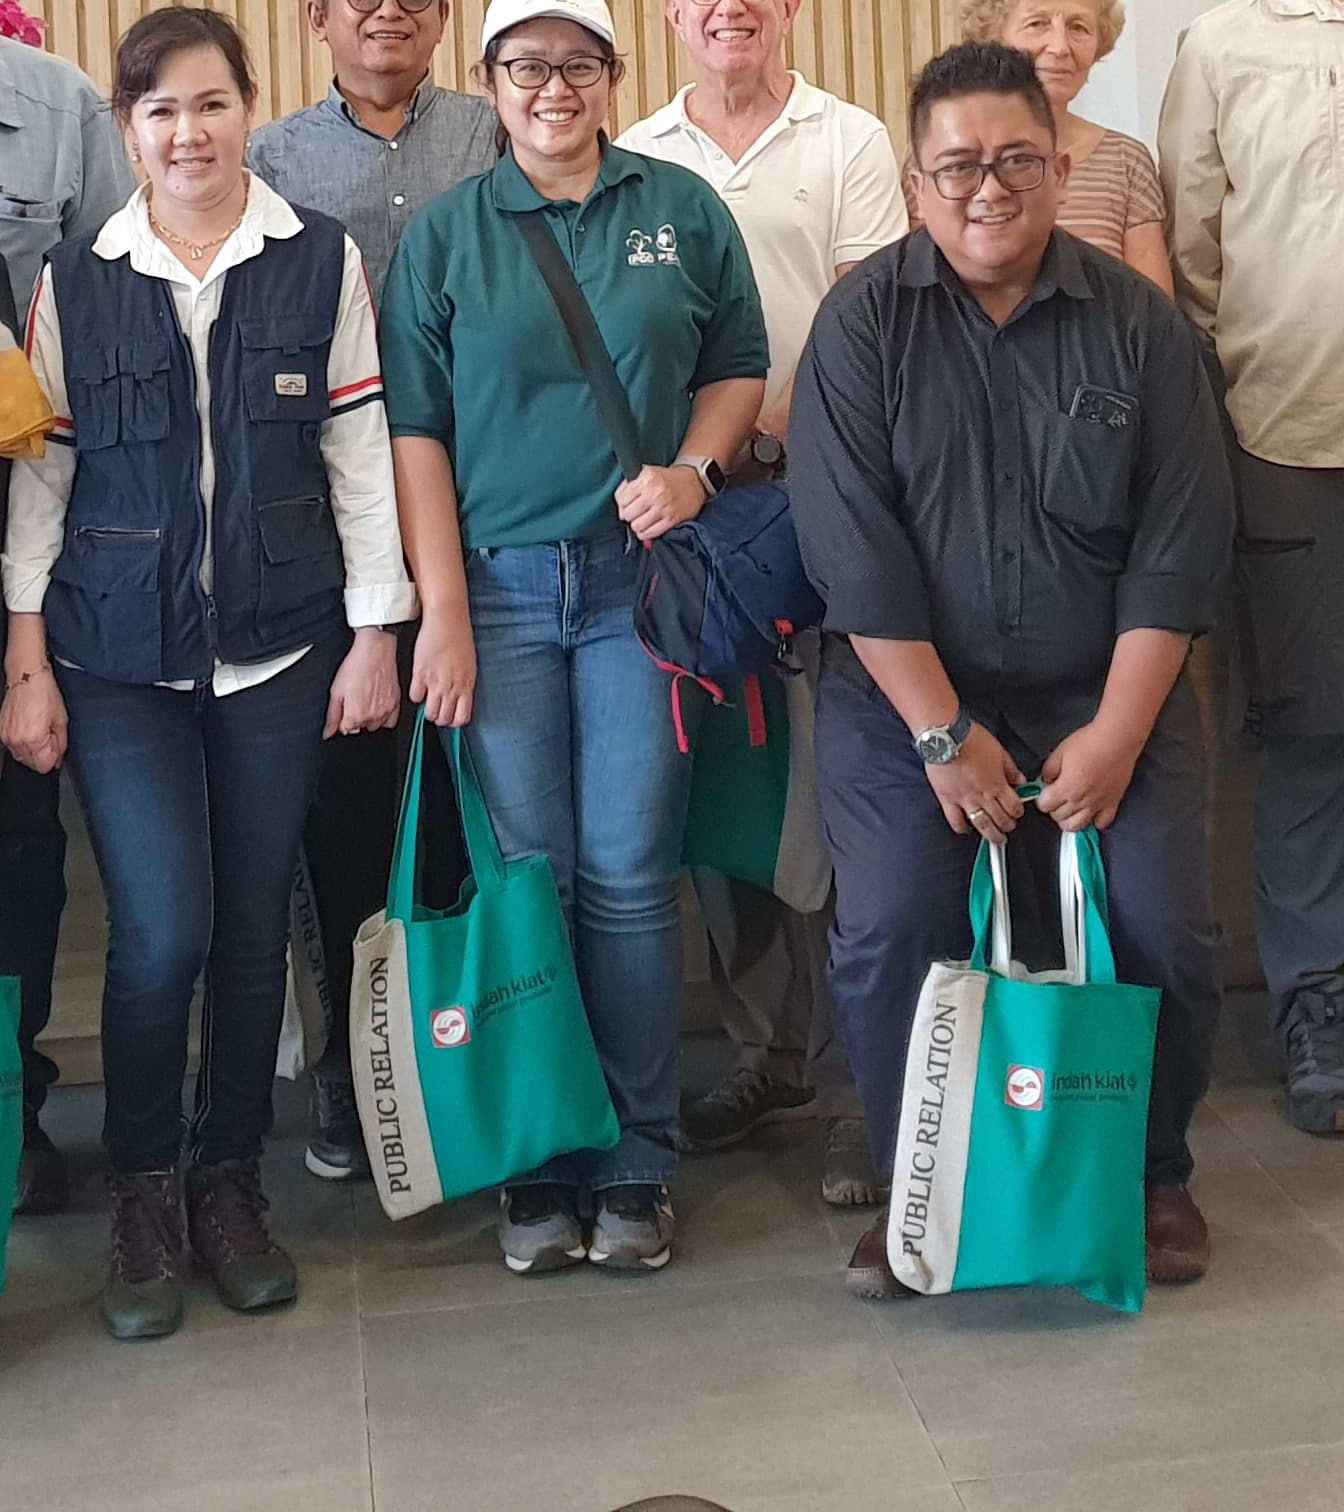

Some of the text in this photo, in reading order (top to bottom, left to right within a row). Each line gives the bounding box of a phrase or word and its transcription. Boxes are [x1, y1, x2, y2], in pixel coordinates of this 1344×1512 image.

[370, 957, 411, 1194] PUBLIC RELATION
[902, 1002, 958, 1257] PUBLIC RELATION
